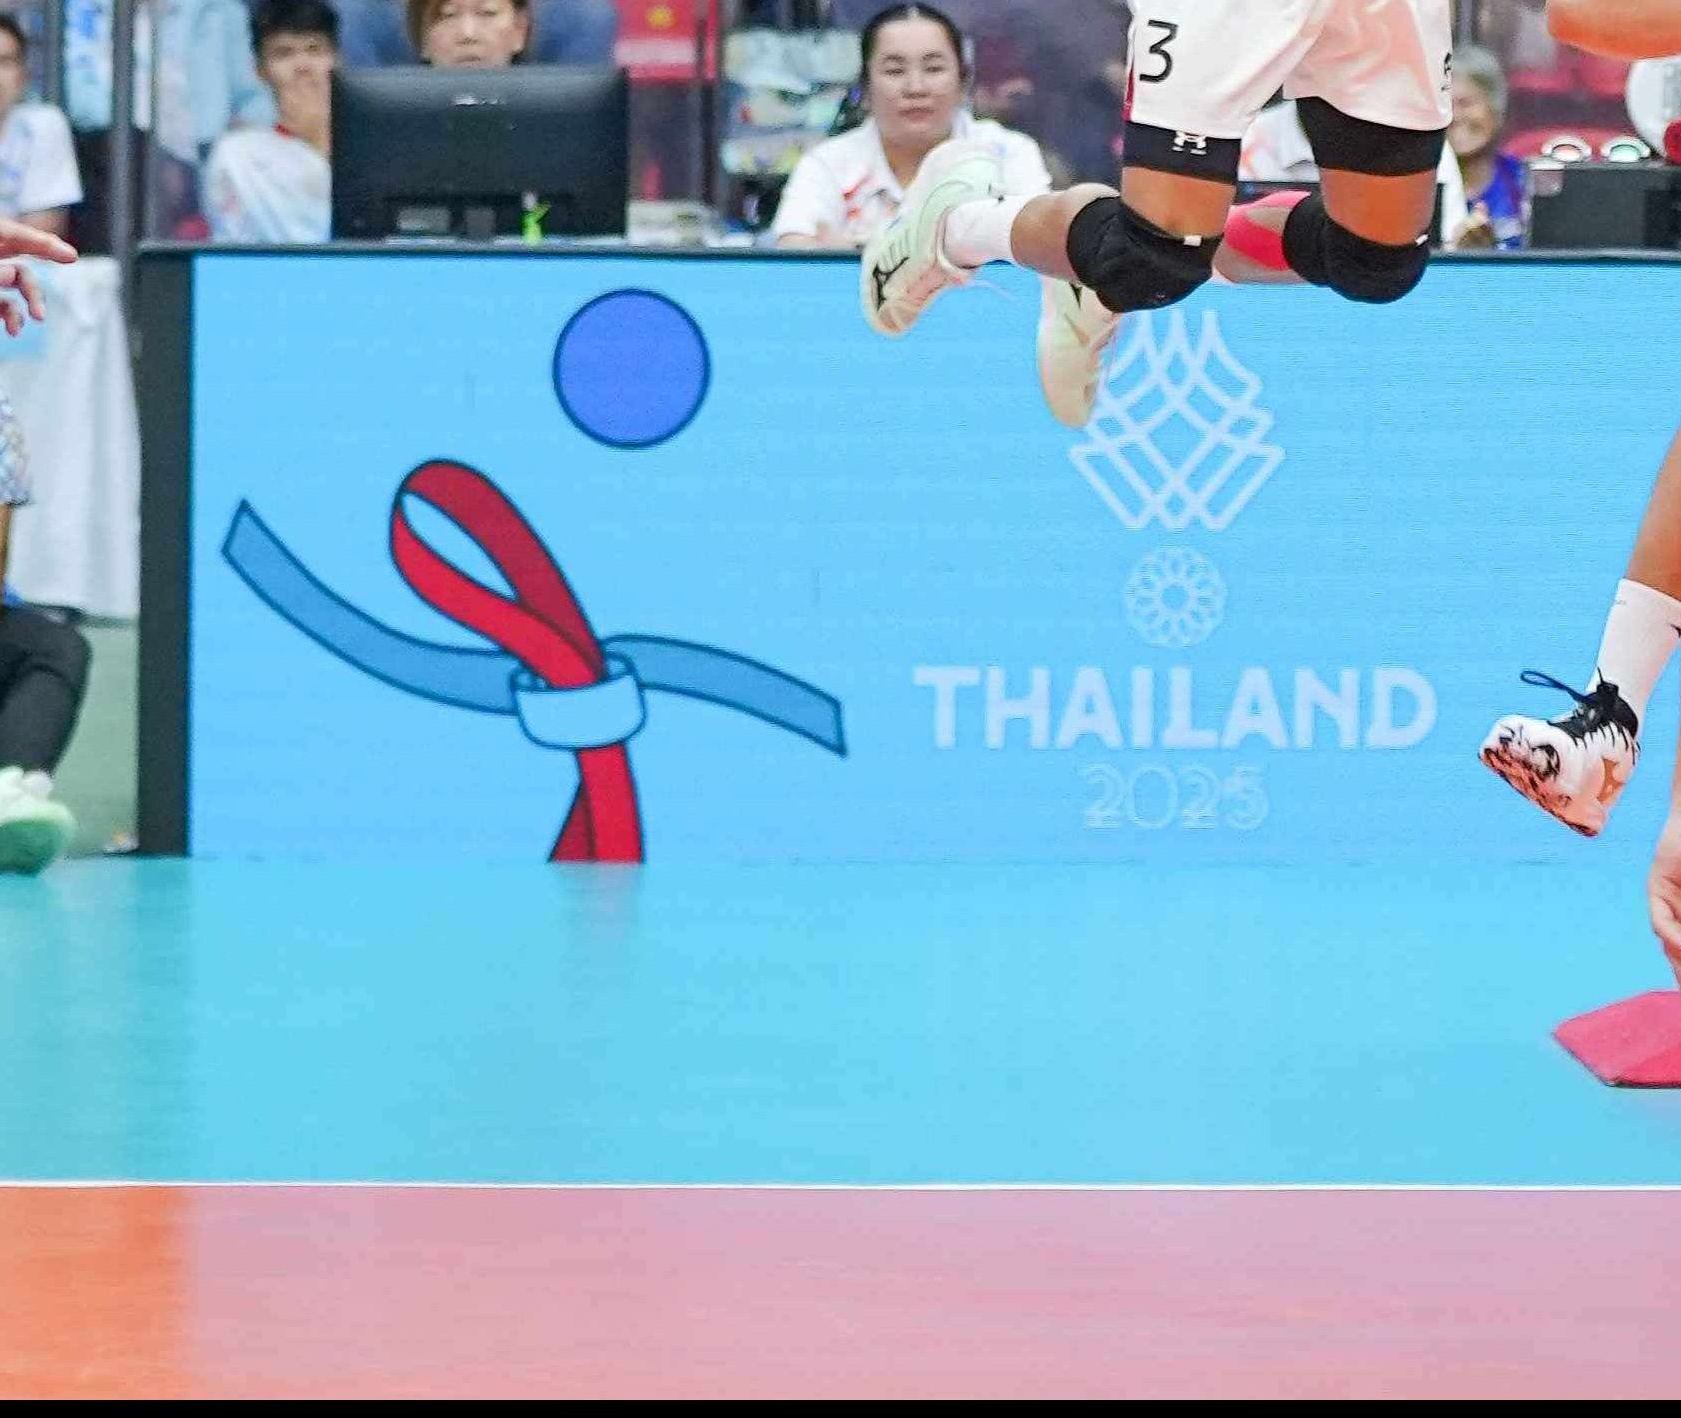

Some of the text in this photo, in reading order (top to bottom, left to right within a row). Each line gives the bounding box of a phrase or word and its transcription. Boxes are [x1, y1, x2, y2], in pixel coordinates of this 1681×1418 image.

[1138, 18, 1180, 84] 3
[912, 665, 1438, 752] THAILAND
[1078, 762, 1270, 832] 2025
